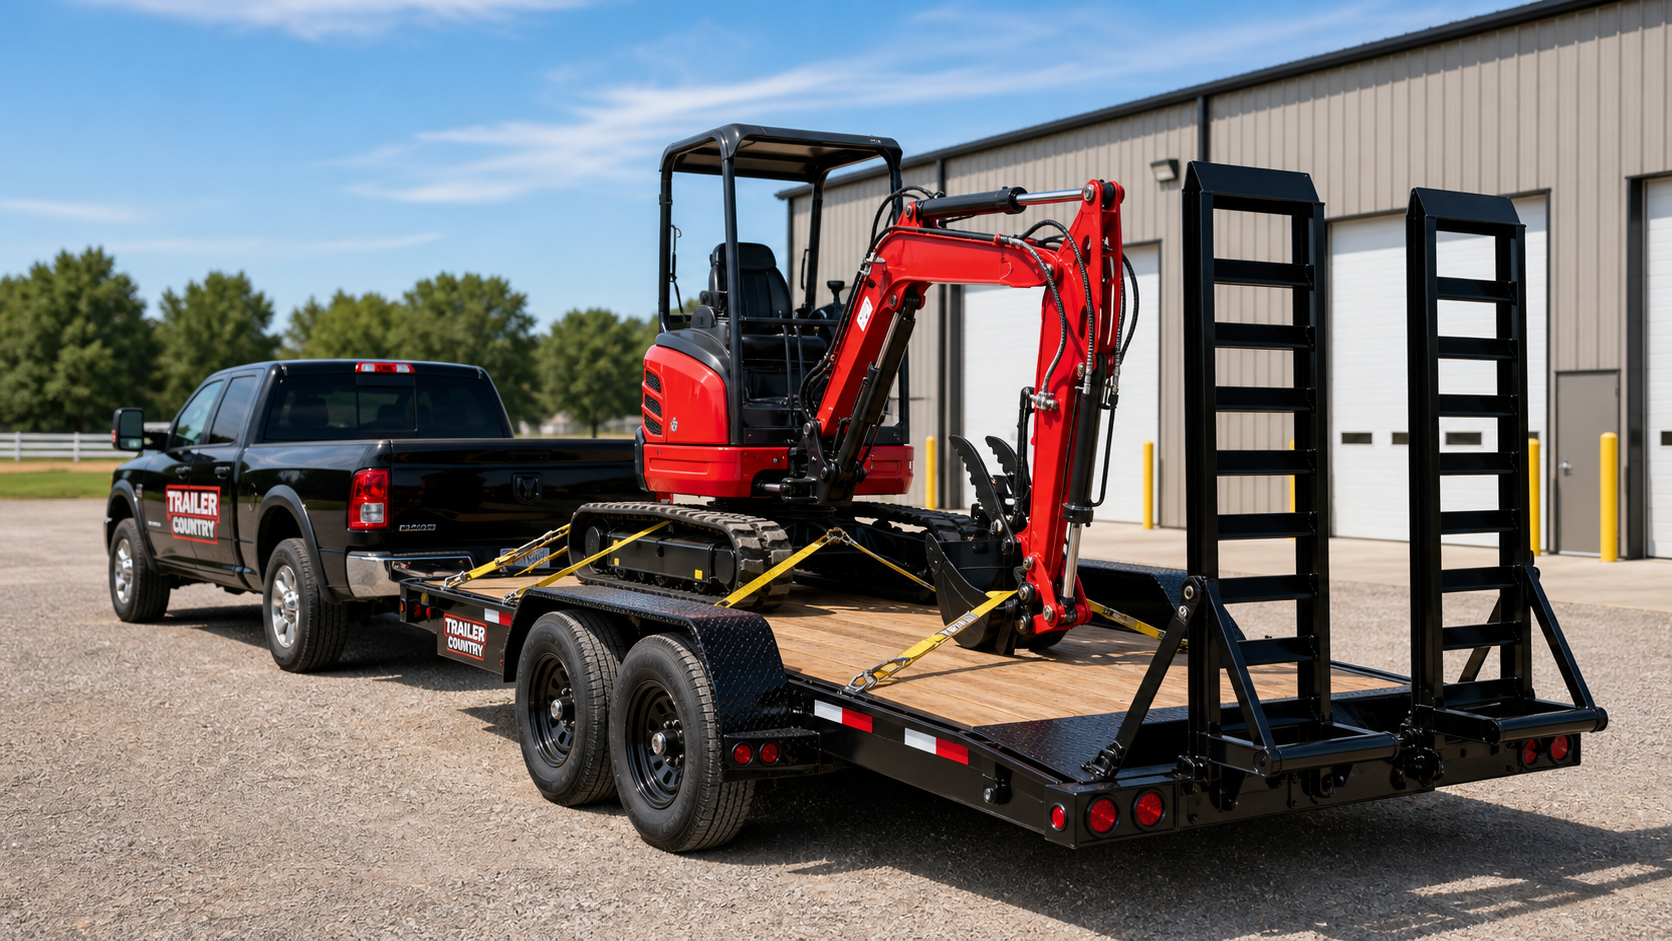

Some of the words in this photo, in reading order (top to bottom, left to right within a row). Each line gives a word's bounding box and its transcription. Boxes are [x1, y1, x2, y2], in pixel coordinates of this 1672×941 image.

[167, 490, 217, 516] TRAILER
[172, 516, 215, 538] COUNTRY
[445, 617, 485, 642] TRAILER
[448, 636, 484, 657] COUNTRY
